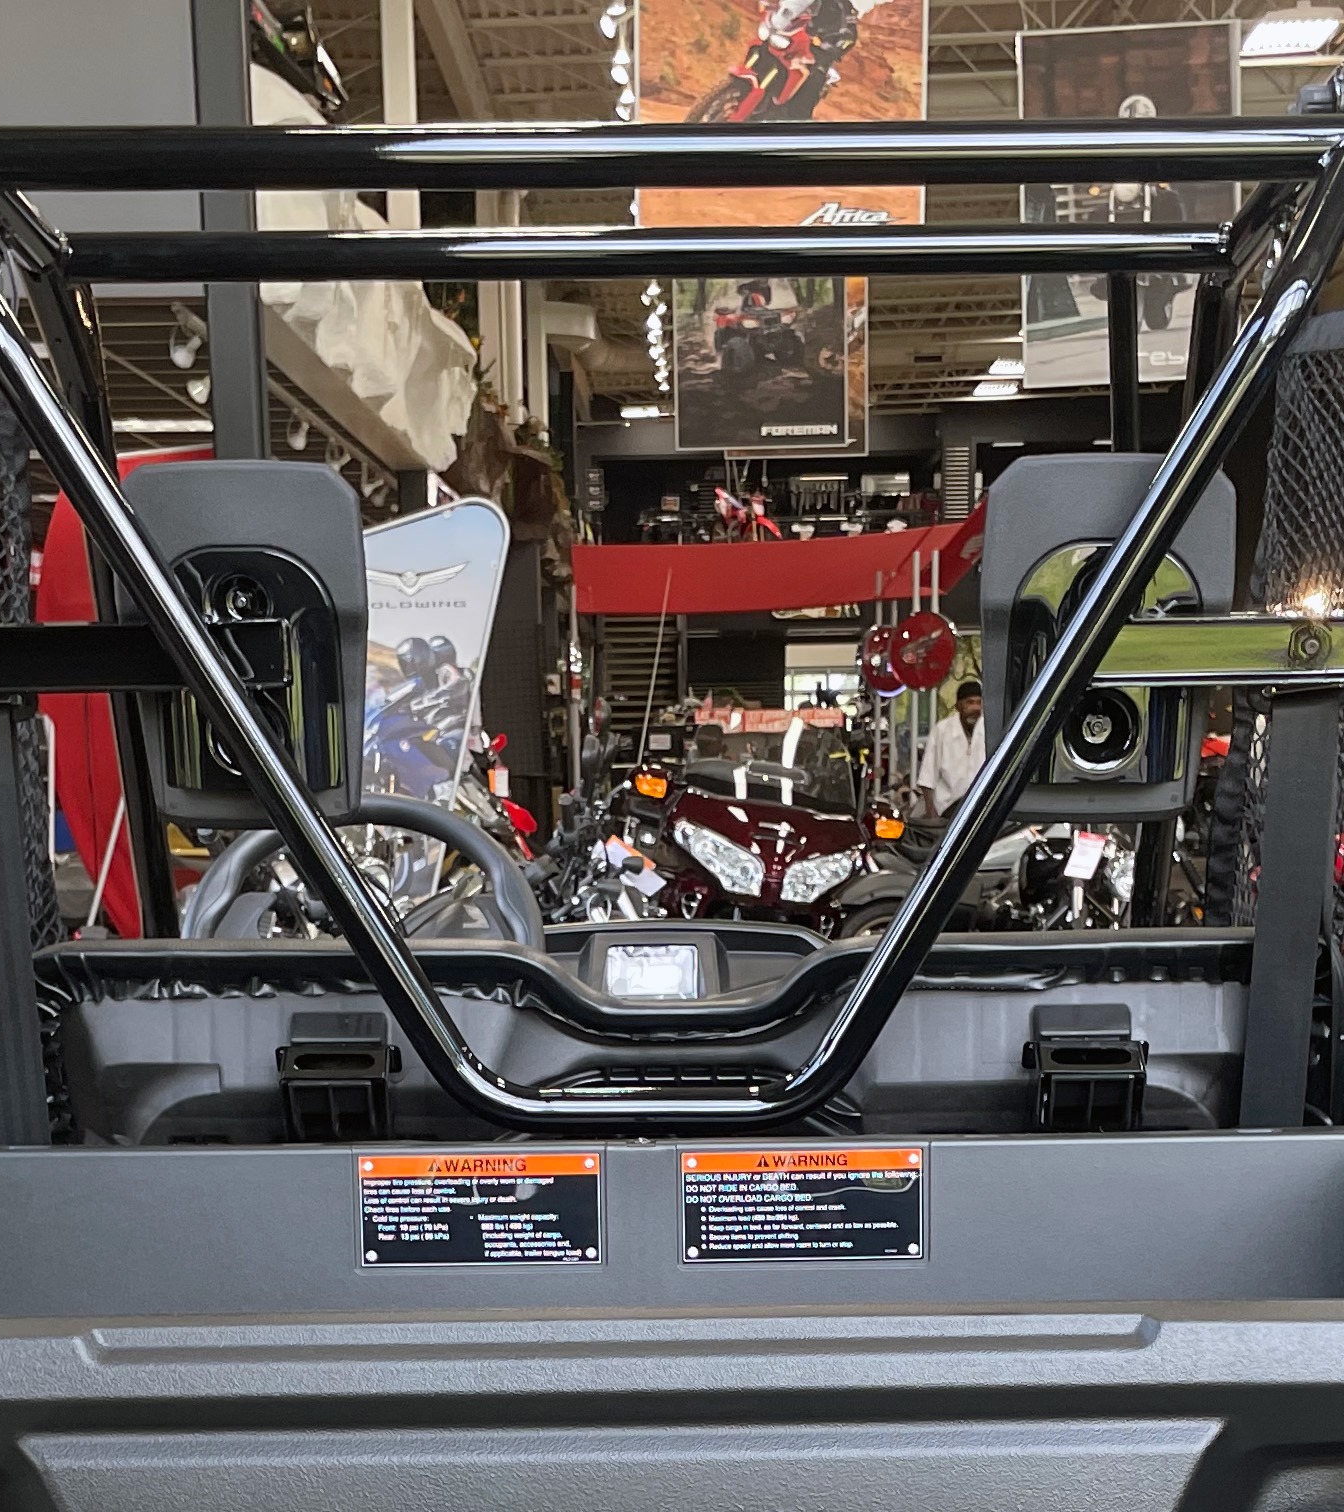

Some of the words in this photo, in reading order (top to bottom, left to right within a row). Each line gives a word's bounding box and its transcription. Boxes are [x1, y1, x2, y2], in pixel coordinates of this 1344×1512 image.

[799, 202, 889, 226] Africa
[761, 424, 838, 437] FOREMAN
[370, 600, 467, 610] OLDWING
[444, 1158, 527, 1172] WARNING
[772, 1153, 848, 1168] WARNING
[686, 1173, 721, 1182] SERIOUS
[723, 1173, 752, 1181] INJURY
[762, 1172, 789, 1182] DEATH
[805, 1172, 825, 1180] result
[827, 1171, 832, 1179] if
[848, 1172, 870, 1180] ignore
[871, 1171, 883, 1179] the
[699, 1184, 716, 1192] NOT
[718, 1184, 737, 1192] RIDE
[749, 1182, 779, 1192] CARGO
[780, 1183, 798, 1192] BED.
[686, 1195, 699, 1203] DO
[700, 1195, 717, 1203] NOT
[718, 1194, 762, 1202] OVERLOAD
[764, 1193, 794, 1202] CARGO
[794, 1193, 814, 1201] BED.
